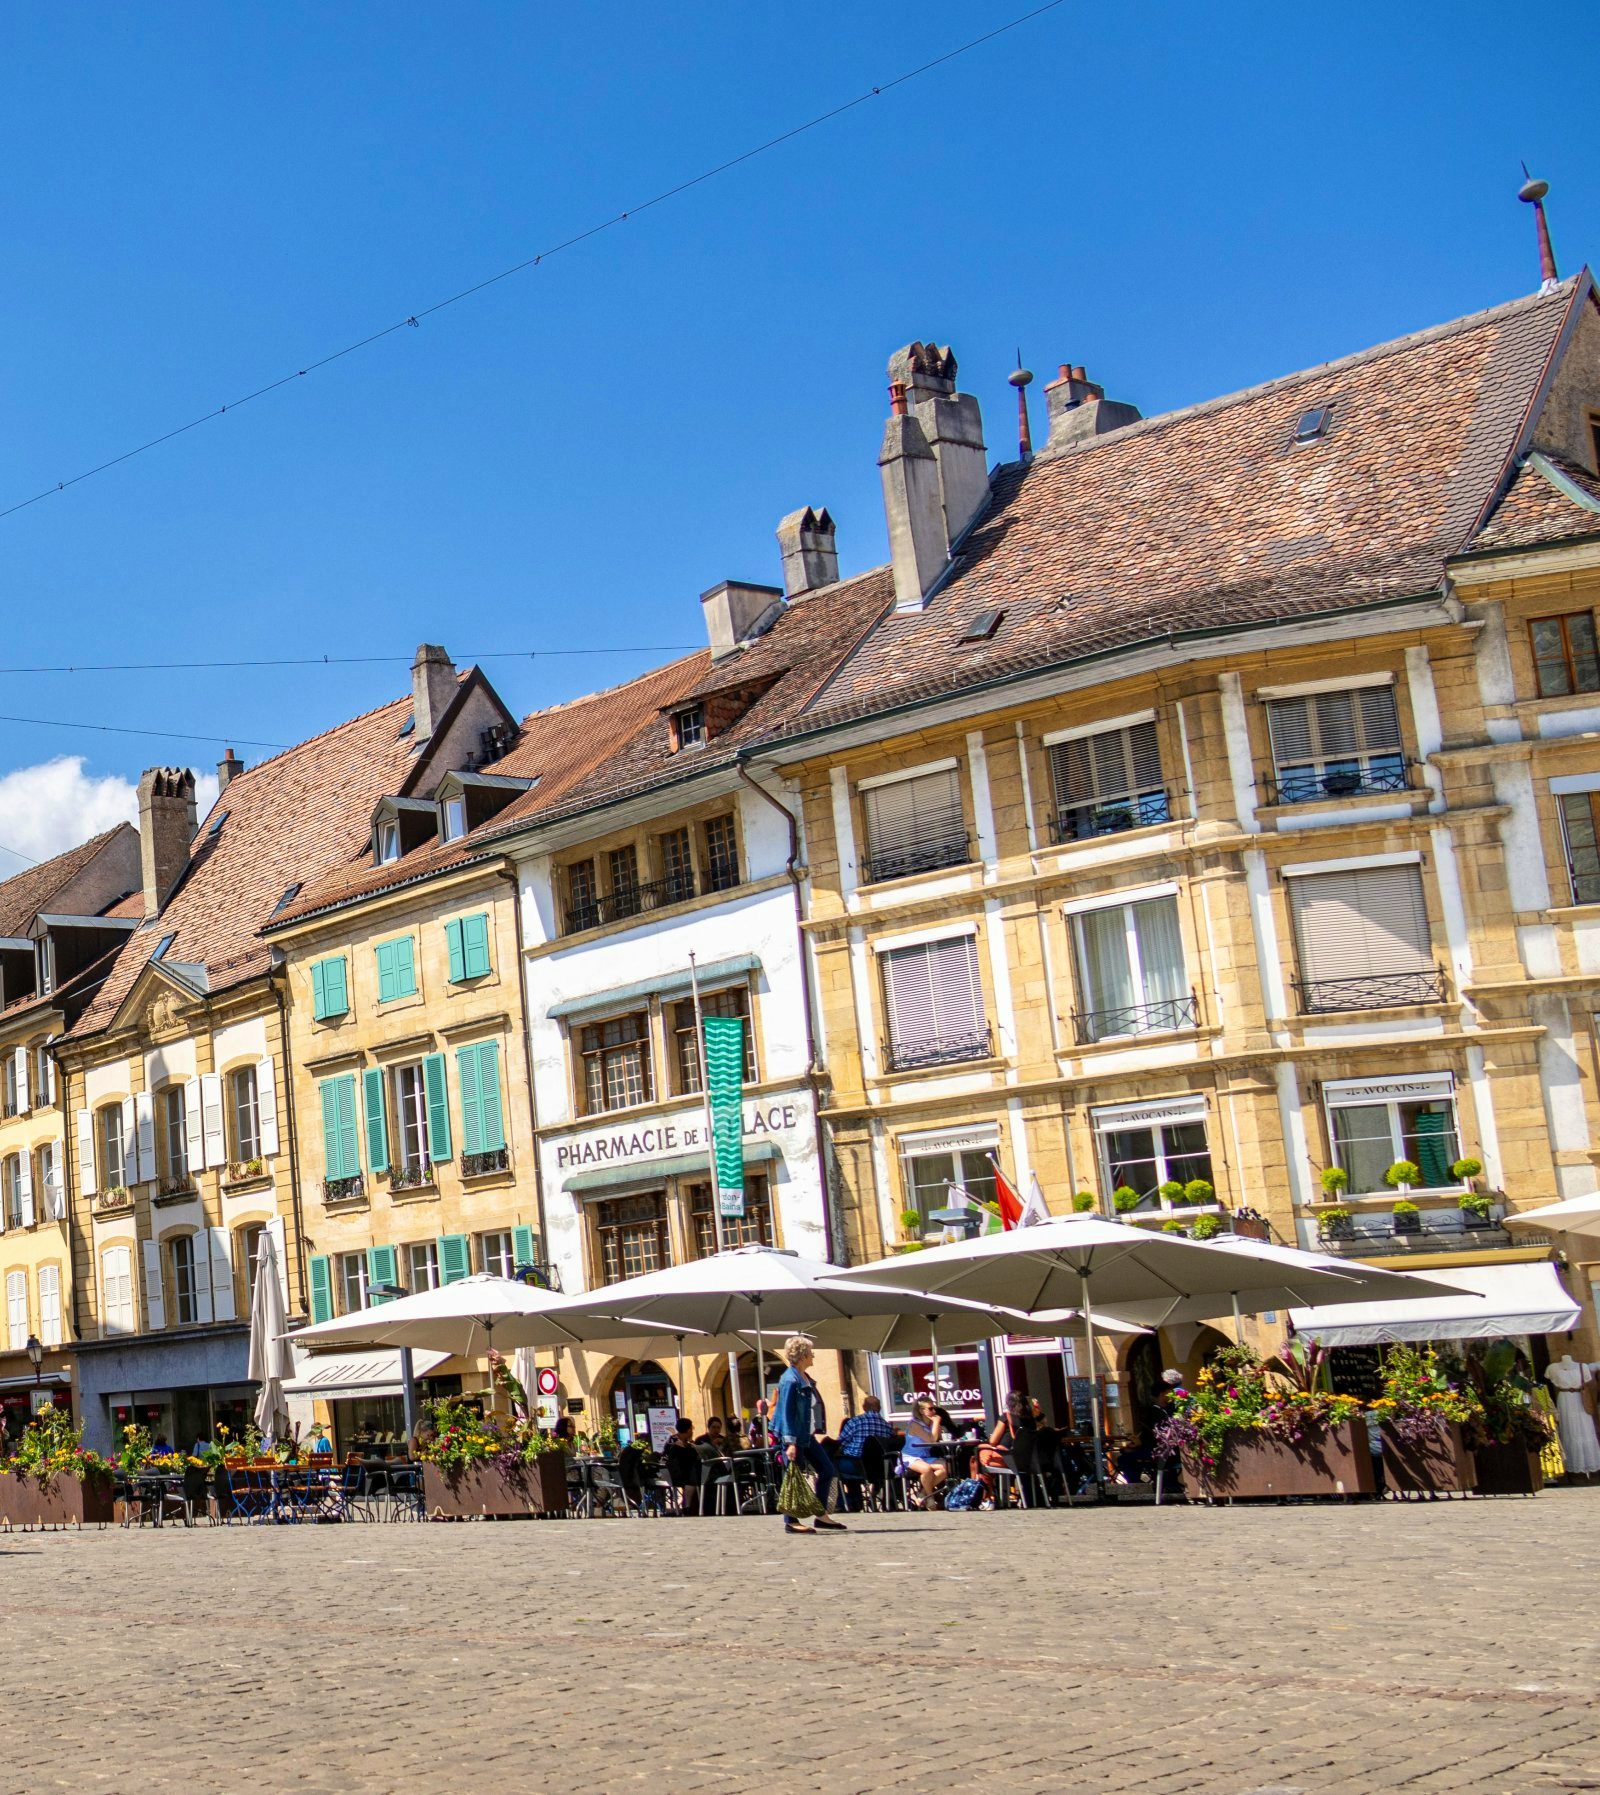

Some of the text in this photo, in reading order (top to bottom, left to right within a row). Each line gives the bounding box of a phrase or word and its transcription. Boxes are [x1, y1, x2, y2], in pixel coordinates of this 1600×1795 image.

[1362, 1083, 1415, 1095] AVOCATS
[1130, 1109, 1173, 1121] AVOCATS
[557, 1126, 677, 1168] PHARMACIE
[684, 1129, 699, 1146] DE
[741, 1105, 797, 1136] LACE
[933, 1138, 972, 1150] AVOCATS
[939, 1389, 982, 1402] TACOS
